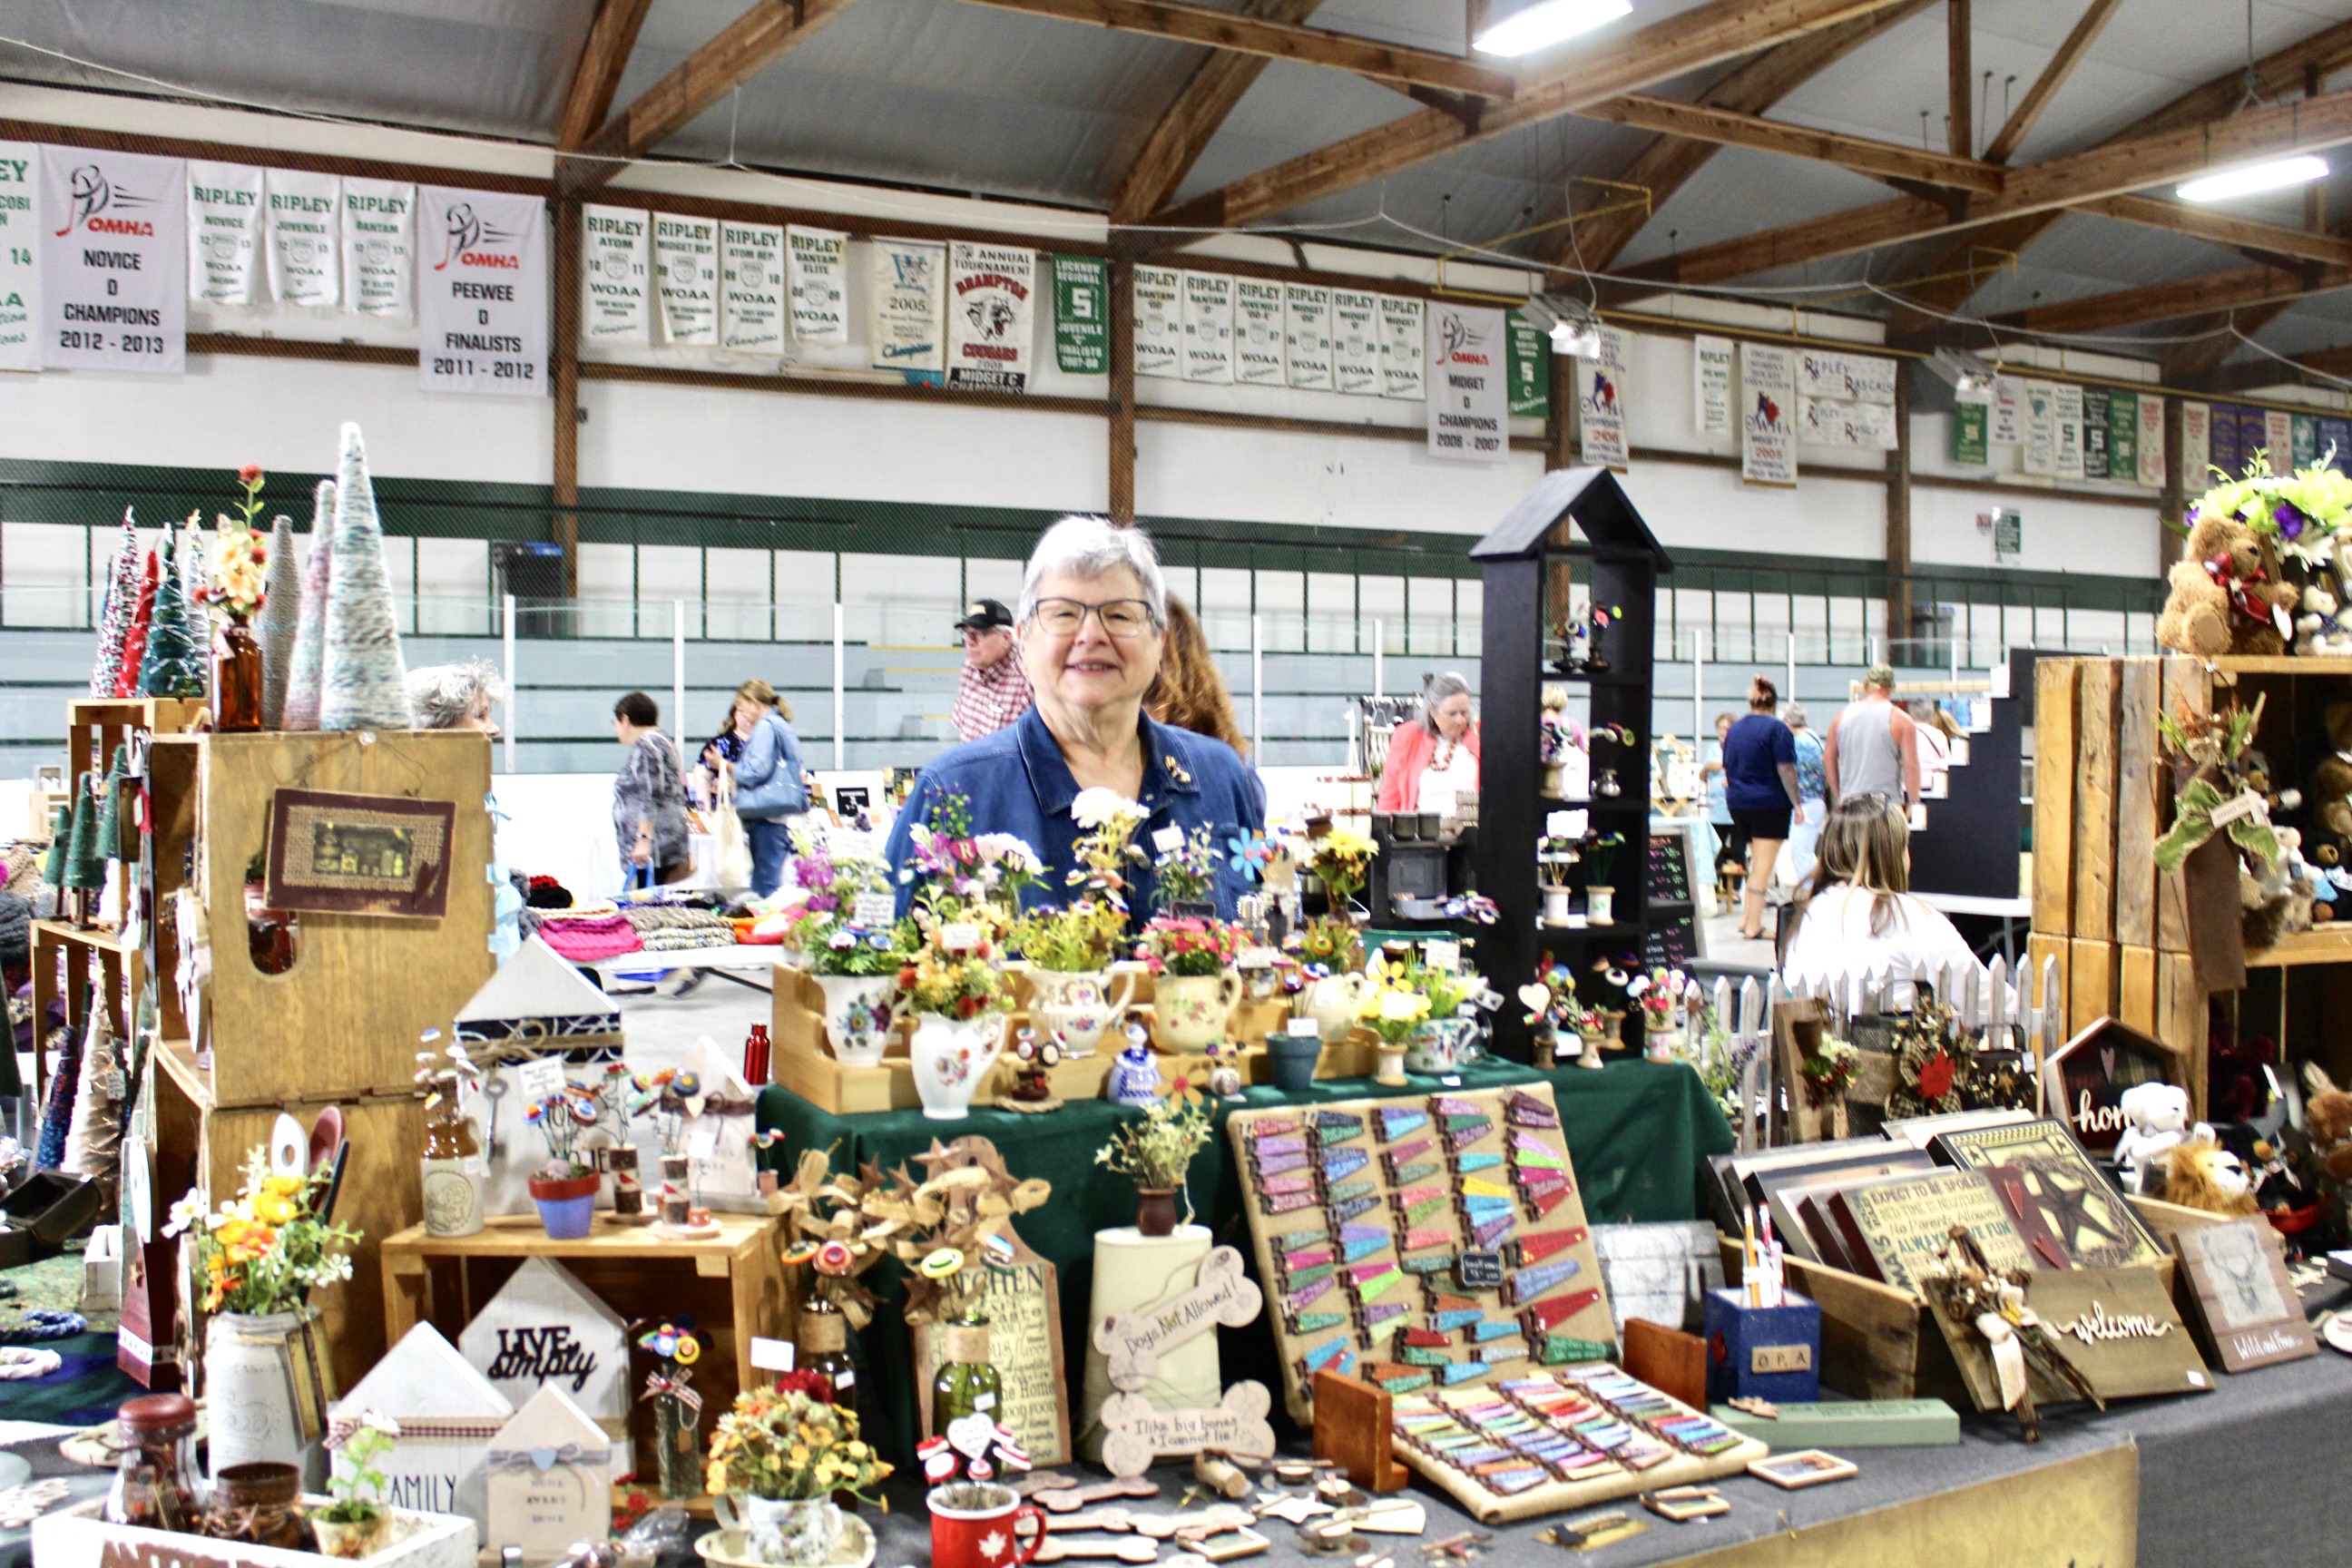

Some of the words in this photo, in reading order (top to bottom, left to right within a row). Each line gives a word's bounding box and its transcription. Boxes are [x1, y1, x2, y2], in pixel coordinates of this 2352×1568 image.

[193, 184, 258, 207] RIPLEY
[270, 193, 334, 213] RIPLEY
[347, 194, 407, 215] RIPLEY
[87, 217, 155, 237] OMHA
[204, 215, 244, 229] NOVICE
[276, 220, 326, 234] JUVENILE
[587, 215, 644, 237] RIPLEY
[658, 220, 712, 240] RIPLEY
[598, 237, 633, 250] ATOM
[725, 229, 779, 247] RIPLEY
[790, 234, 843, 253] RIPLEY
[83, 249, 142, 270] NOVICE
[461, 251, 520, 270] OMHA
[729, 248, 755, 260] ATOM
[795, 252, 838, 265] BANTAM
[979, 249, 1032, 265] ANNUAL
[953, 260, 1032, 277] TOURNAMENT
[107, 278, 118, 296] D
[1134, 269, 1178, 287] RIPLEY
[1186, 276, 1230, 294] RIPLEY
[452, 281, 514, 302] PEEWEE
[590, 282, 642, 298] WOAA
[660, 287, 710, 300] WOAA
[955, 273, 1030, 302] BRAMPTON
[1239, 282, 1281, 300] RIPLEY
[1287, 286, 1328, 304] RIPLEY
[727, 290, 777, 305] WOAA
[888, 297, 926, 312] 2005
[1335, 292, 1376, 309] RIPLEY
[64, 302, 161, 327] CHAMPIONS
[792, 309, 840, 323] WOAA
[1381, 298, 1421, 316] RIPLEY
[478, 309, 489, 326] D
[60, 329, 103, 351] 2012
[122, 335, 164, 354] 2013
[446, 332, 522, 354] FINALISTS
[1135, 343, 1176, 357] WOAA
[1188, 348, 1228, 363] WOAA
[1240, 351, 1279, 366] WOAA
[1452, 351, 1489, 367] OMHA
[433, 358, 474, 377] 2011
[494, 361, 534, 380] 2012
[1290, 358, 1328, 373] WOAA
[1338, 363, 1375, 377] WOAA
[1384, 368, 1420, 380] WOAA
[1805, 356, 1851, 381] RIPLEY
[1448, 373, 1485, 390] MIDGET
[1438, 413, 1498, 432] CHAMPIONS
[1475, 436, 1500, 451] 2007
[1869, 1186, 1911, 1206] EXPECT
[1913, 1185, 1928, 1198] TO
[1926, 1180, 1944, 1195] BE
[1944, 1175, 1986, 1192] SPOILED
[1890, 1221, 1906, 1237] No
[1956, 1204, 2003, 1222] Allowed
[1985, 1221, 2012, 1237] FUN
[2057, 1299, 2173, 1346] welcome
[496, 1326, 571, 1355] LIVE
[1124, 1328, 1161, 1357] Dogs
[2232, 1334, 2266, 1361] Wild
[487, 1341, 599, 1392] simply
[1174, 1416, 1196, 1436] big
